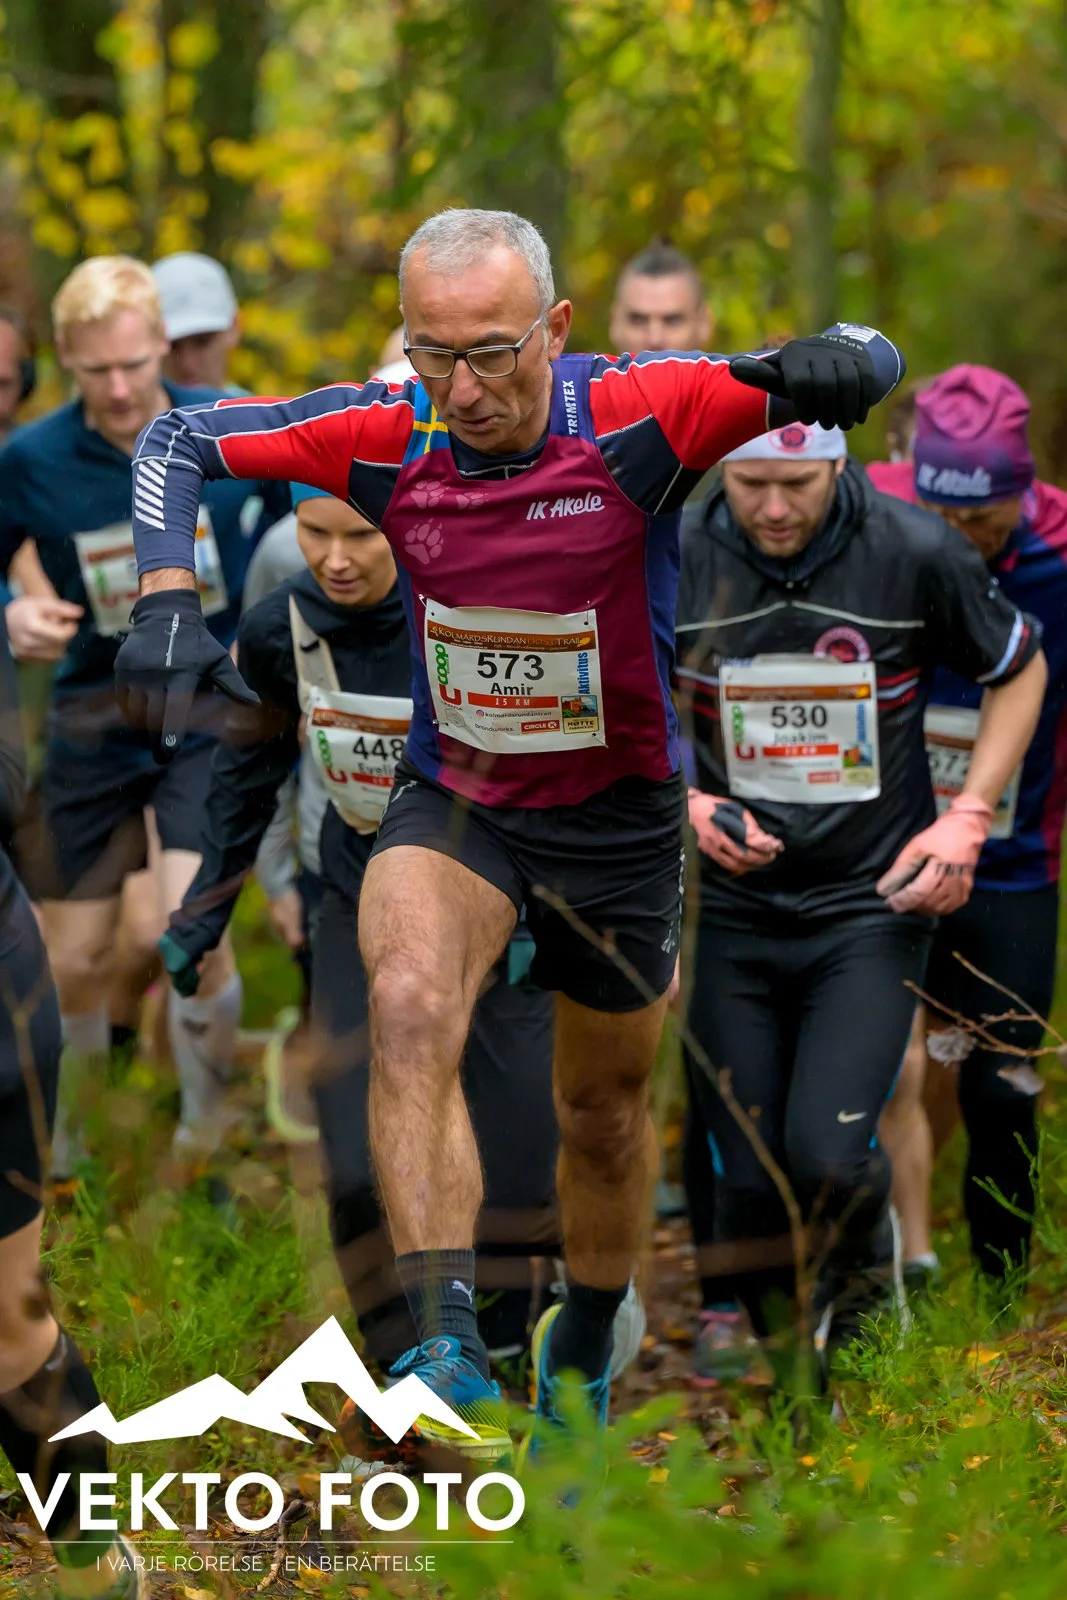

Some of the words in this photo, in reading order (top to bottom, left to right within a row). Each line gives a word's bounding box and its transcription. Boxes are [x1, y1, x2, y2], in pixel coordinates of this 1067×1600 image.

[562, 380, 578, 435] TRIMTEX
[526, 501, 550, 521] IK
[477, 652, 545, 681] 573
[576, 652, 590, 695] Aktivitus
[490, 682, 534, 696] Amir
[495, 697, 508, 706] 15
[515, 697, 531, 707] KM
[771, 705, 828, 729] 530
[353, 736, 405, 760] 448
